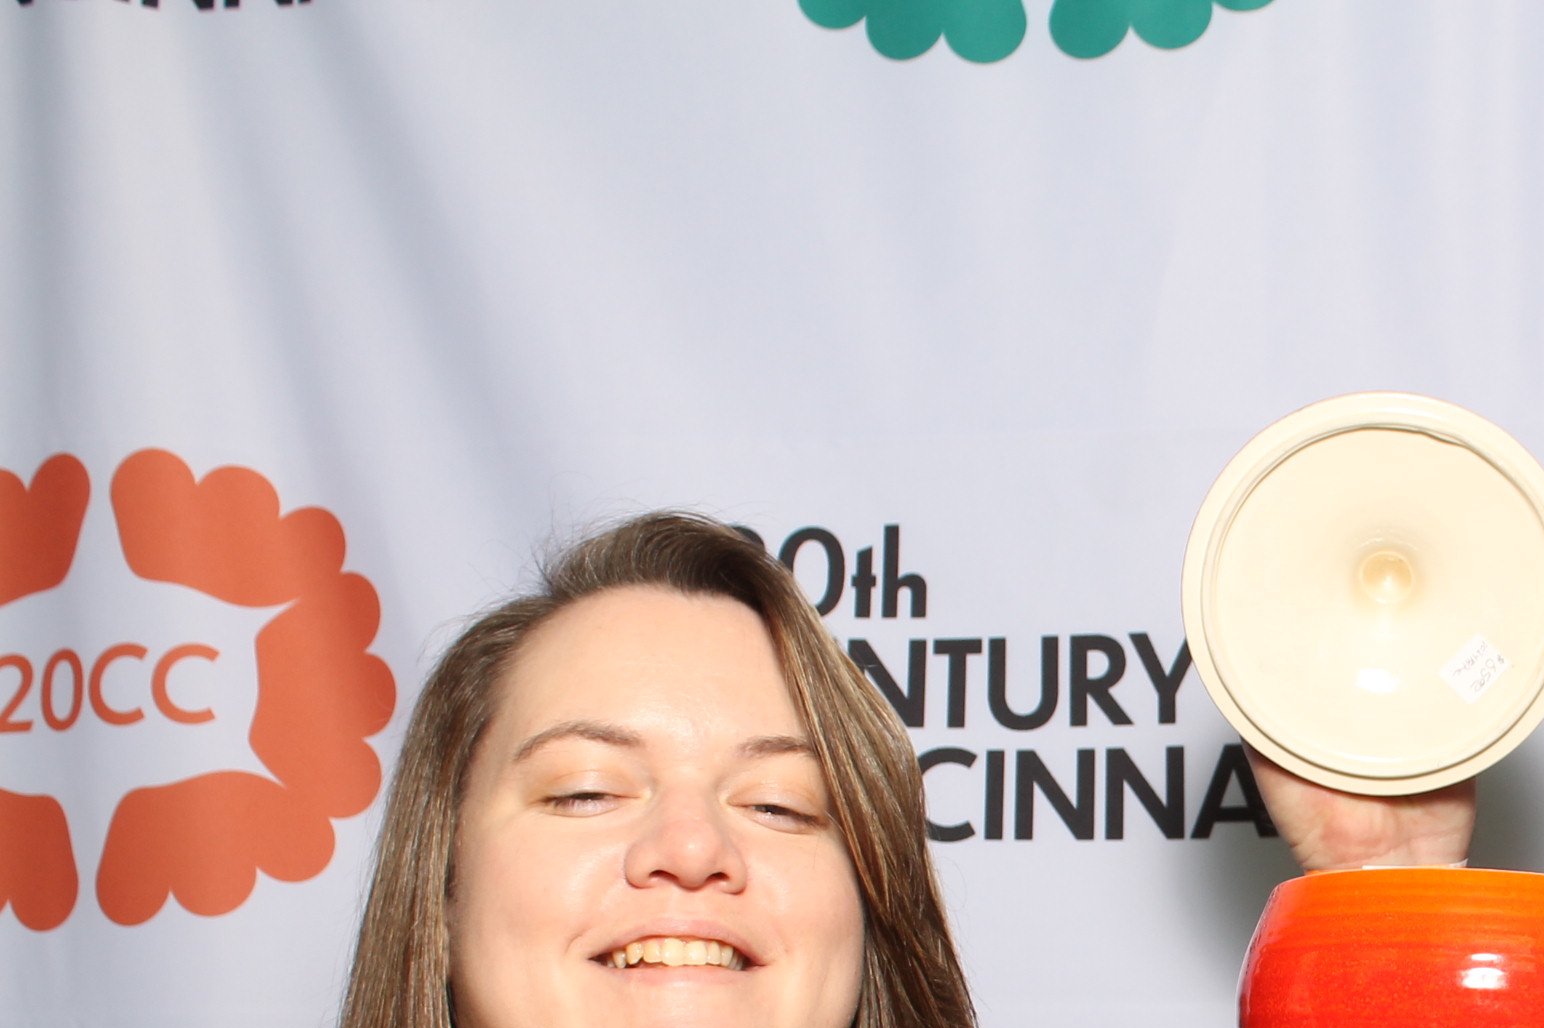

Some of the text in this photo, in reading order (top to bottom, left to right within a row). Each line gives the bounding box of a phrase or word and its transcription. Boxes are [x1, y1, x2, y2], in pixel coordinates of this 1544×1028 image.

[733, 525, 927, 618] 0th
[0, 642, 220, 733] 20CC
[840, 632, 1194, 730] NTURY
[917, 744, 1280, 843] CINNA
